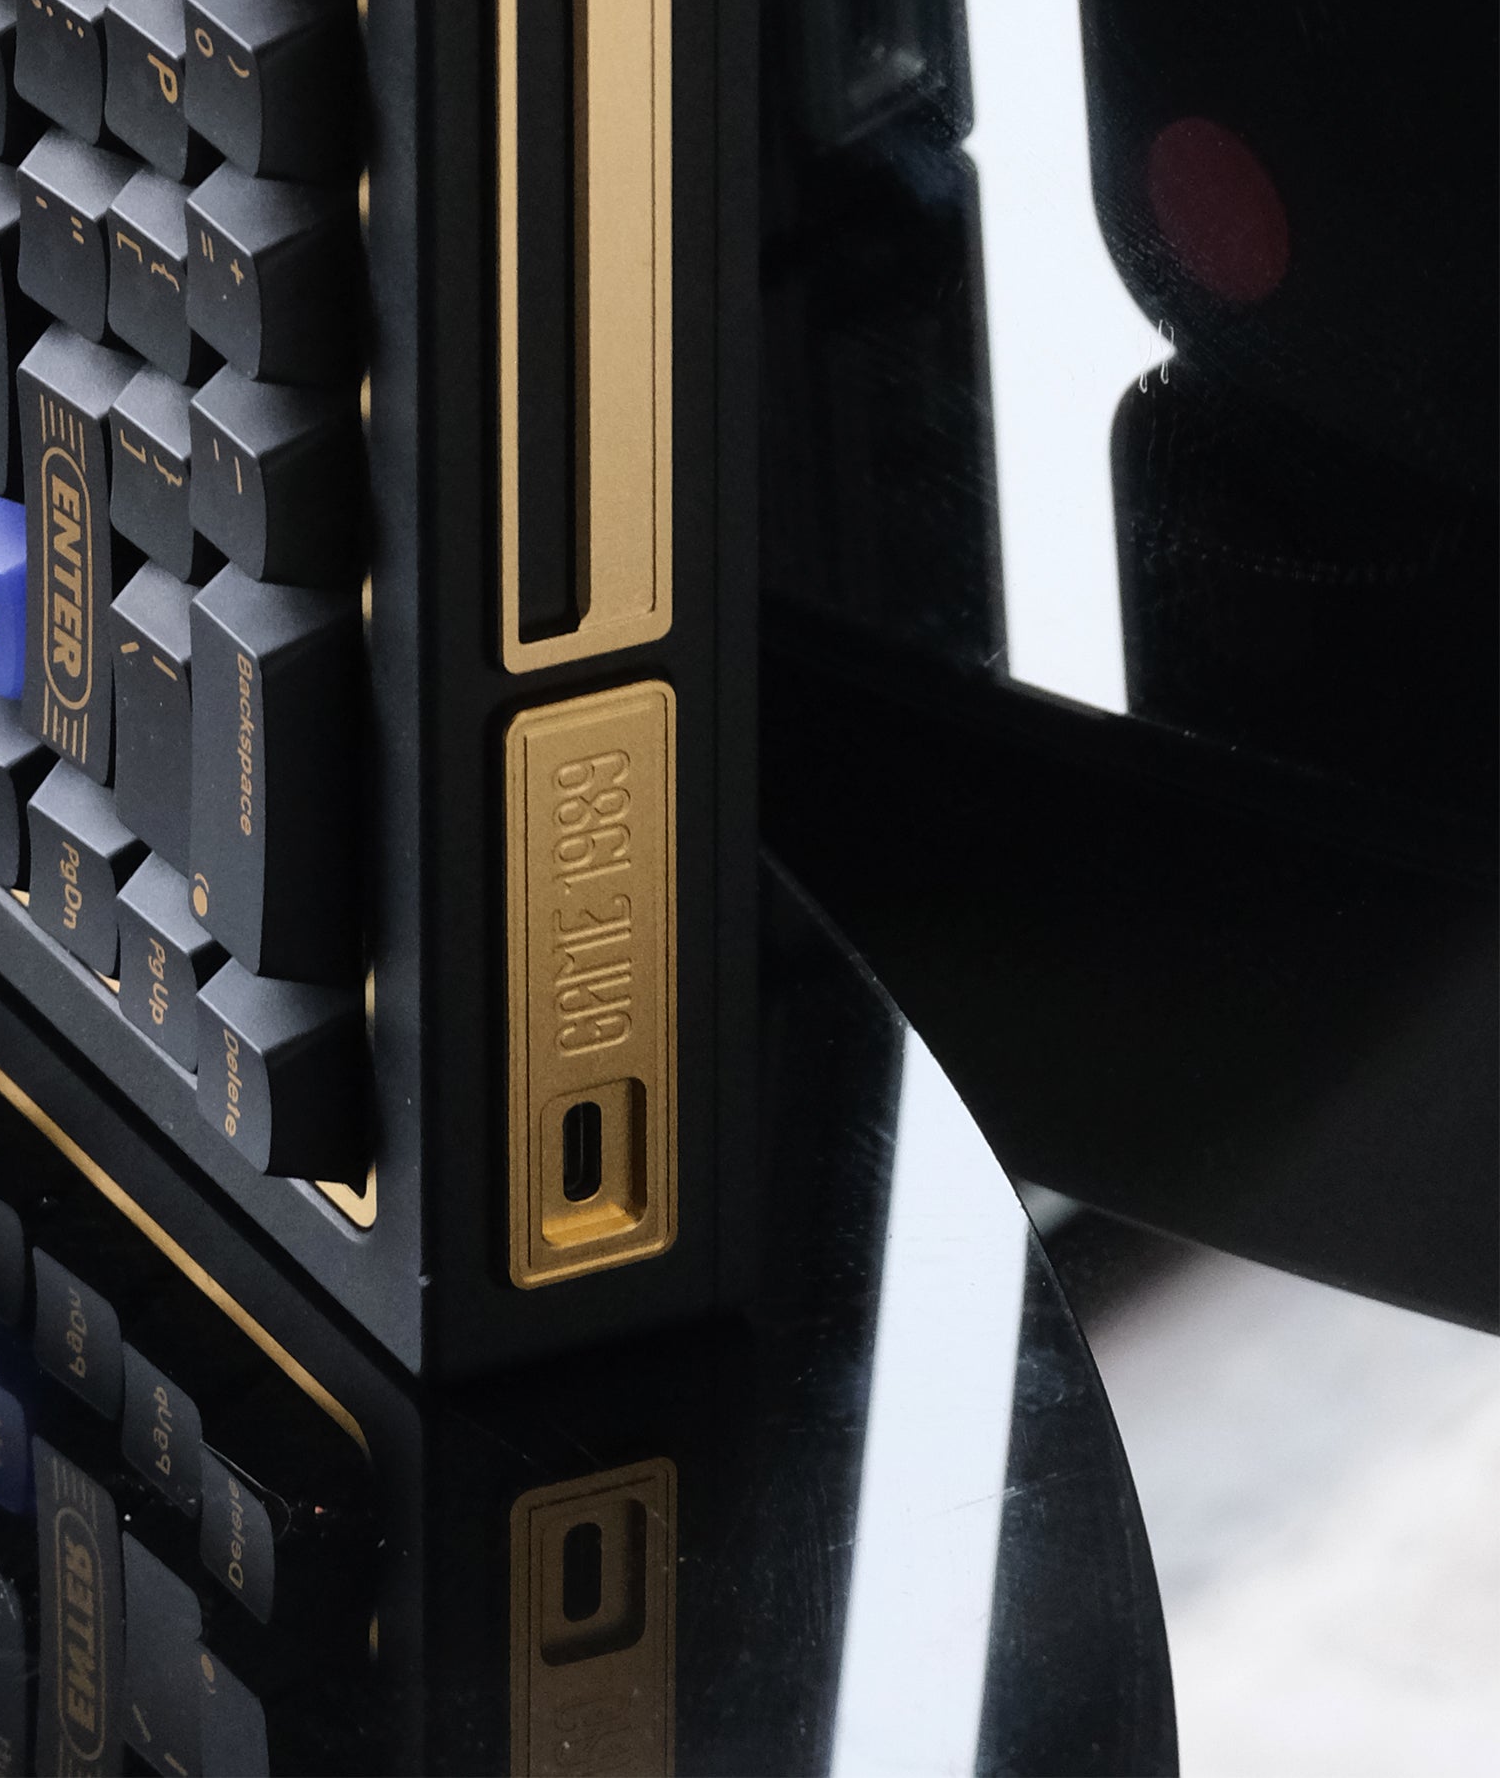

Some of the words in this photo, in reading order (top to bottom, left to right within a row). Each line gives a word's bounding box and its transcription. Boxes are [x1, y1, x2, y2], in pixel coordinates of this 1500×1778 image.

[148, 54, 177, 103] P
[231, 259, 244, 285] +
[52, 475, 82, 677] ENTER
[238, 653, 254, 835] Backspace
[552, 749, 632, 895] 1989
[555, 895, 632, 1058] GAME
[224, 1030, 242, 1137] Delete
